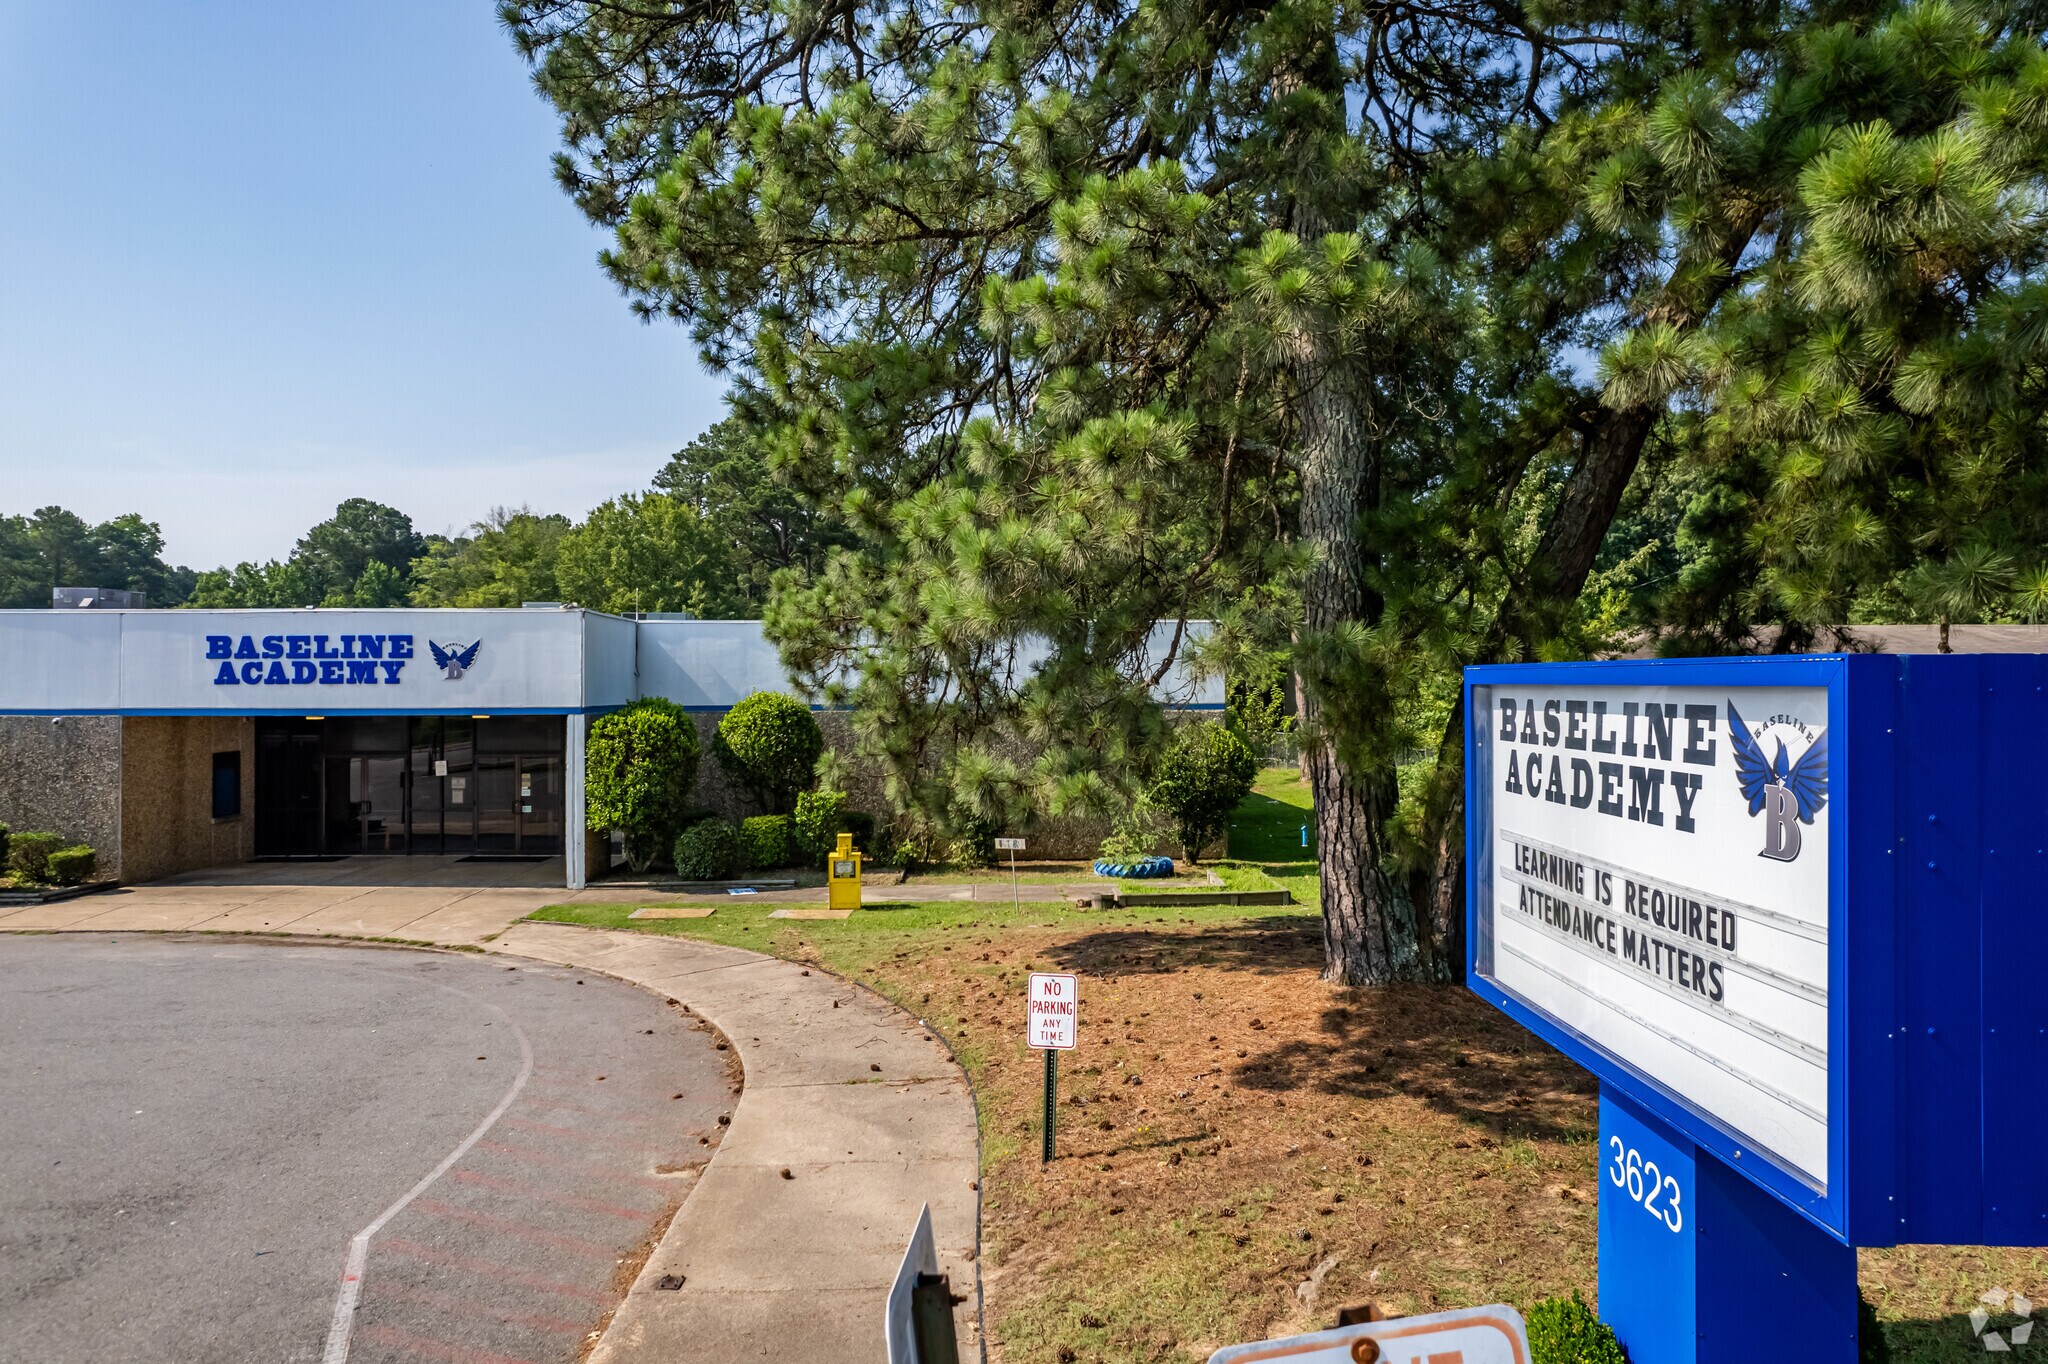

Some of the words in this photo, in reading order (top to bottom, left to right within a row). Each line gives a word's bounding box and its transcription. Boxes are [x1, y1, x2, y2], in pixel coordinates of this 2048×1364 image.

[206, 635, 413, 659] BASELINE
[214, 661, 405, 685] ACADEMY
[1499, 698, 1717, 767] BASELINE
[1754, 714, 1814, 744] BASELINE
[1505, 749, 1703, 834] ACADEMY
[1758, 784, 1801, 863] B
[1514, 842, 1584, 896] LEARNING
[1595, 869, 1612, 906] IS
[1625, 879, 1736, 952] REQUIRED
[1519, 884, 1617, 955] ATTENDANCE
[1623, 926, 1723, 1002] MATTERS
[1044, 982, 1062, 996] NO
[1032, 1000, 1073, 1016] PARKING
[1040, 1031, 1064, 1042] TIME
[1042, 1019, 1062, 1029] ANY
[1609, 1135, 1683, 1234] 3623
